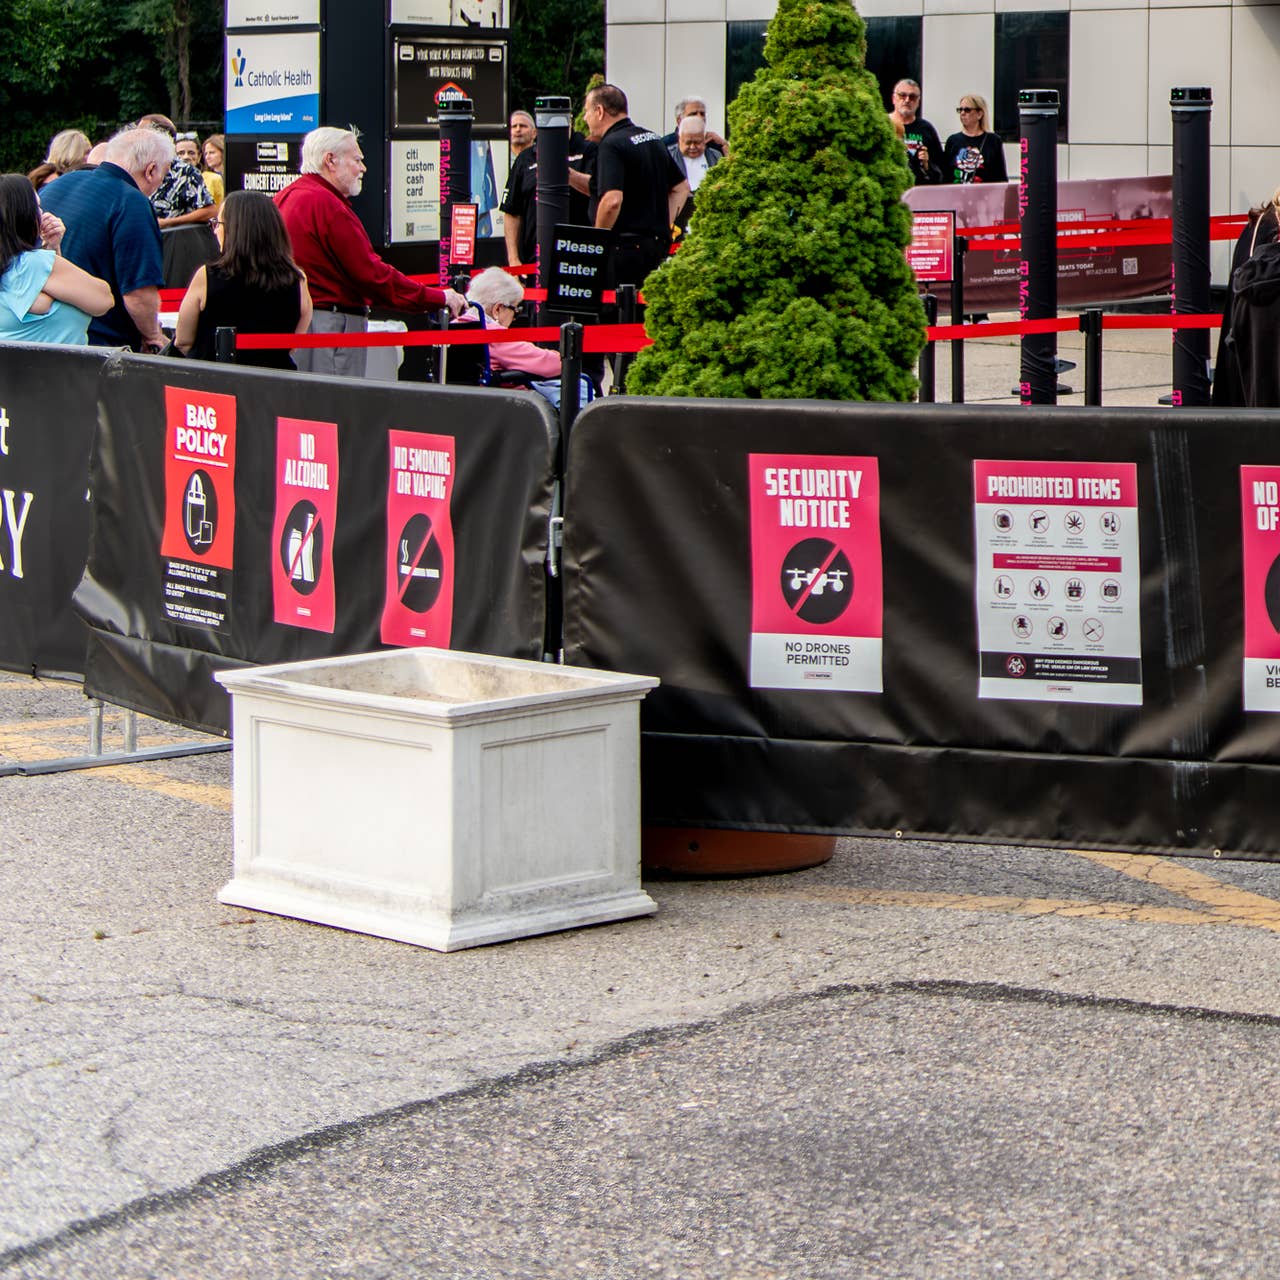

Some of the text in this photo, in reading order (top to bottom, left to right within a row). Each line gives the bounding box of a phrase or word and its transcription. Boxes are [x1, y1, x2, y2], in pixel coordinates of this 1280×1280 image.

[248, 69, 312, 87] Catholic Health
[406, 149, 419, 160] citi
[406, 161, 435, 172] custom
[406, 173, 425, 185] cash
[440, 155, 451, 205] Mobile
[406, 185, 424, 197] card
[557, 239, 604, 255] Please
[559, 262, 598, 276] Enter
[558, 284, 593, 298] Here
[186, 404, 217, 431] BAG
[176, 426, 228, 457] POLICY
[300, 433, 315, 460] NO
[394, 446, 451, 476] NO SMOKING
[284, 458, 329, 490] ALCOHOL
[397, 471, 446, 500] OR VAPING
[765, 468, 862, 499] SECURITY
[988, 476, 1121, 500] PROHIBITED ITEMS
[1253, 481, 1278, 505] NO
[780, 499, 850, 529] NOTICE
[1257, 507, 1280, 530] OF
[786, 642, 851, 654] NO DRONES
[786, 654, 850, 667] PERMITTED
[1266, 678, 1280, 688] BE
